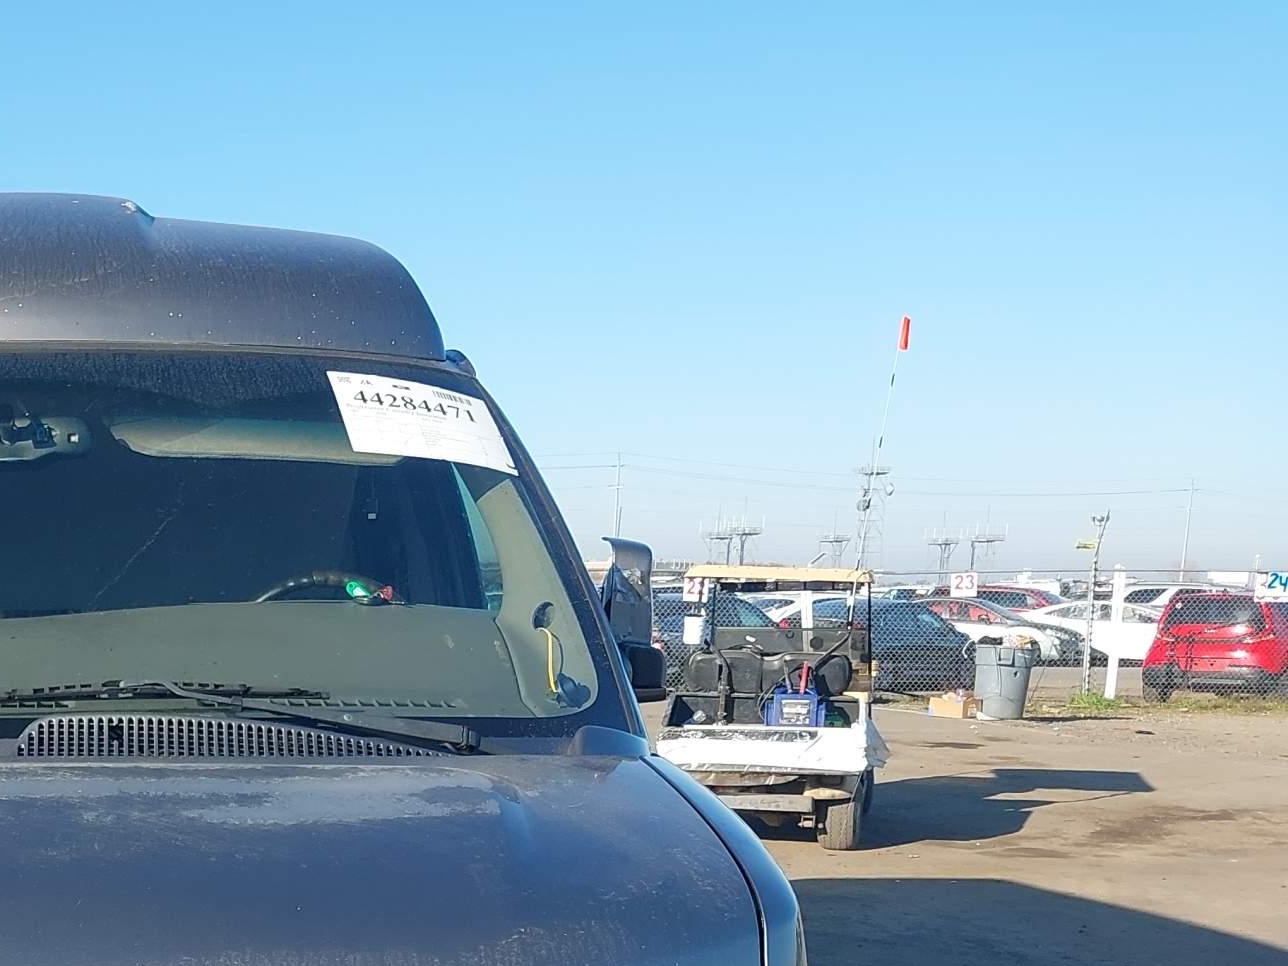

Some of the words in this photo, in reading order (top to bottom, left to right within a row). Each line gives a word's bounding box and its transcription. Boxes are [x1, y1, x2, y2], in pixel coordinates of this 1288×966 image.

[353, 390, 477, 423] 44284471
[954, 574, 975, 590] 23
[1267, 572, 1288, 592] 24
